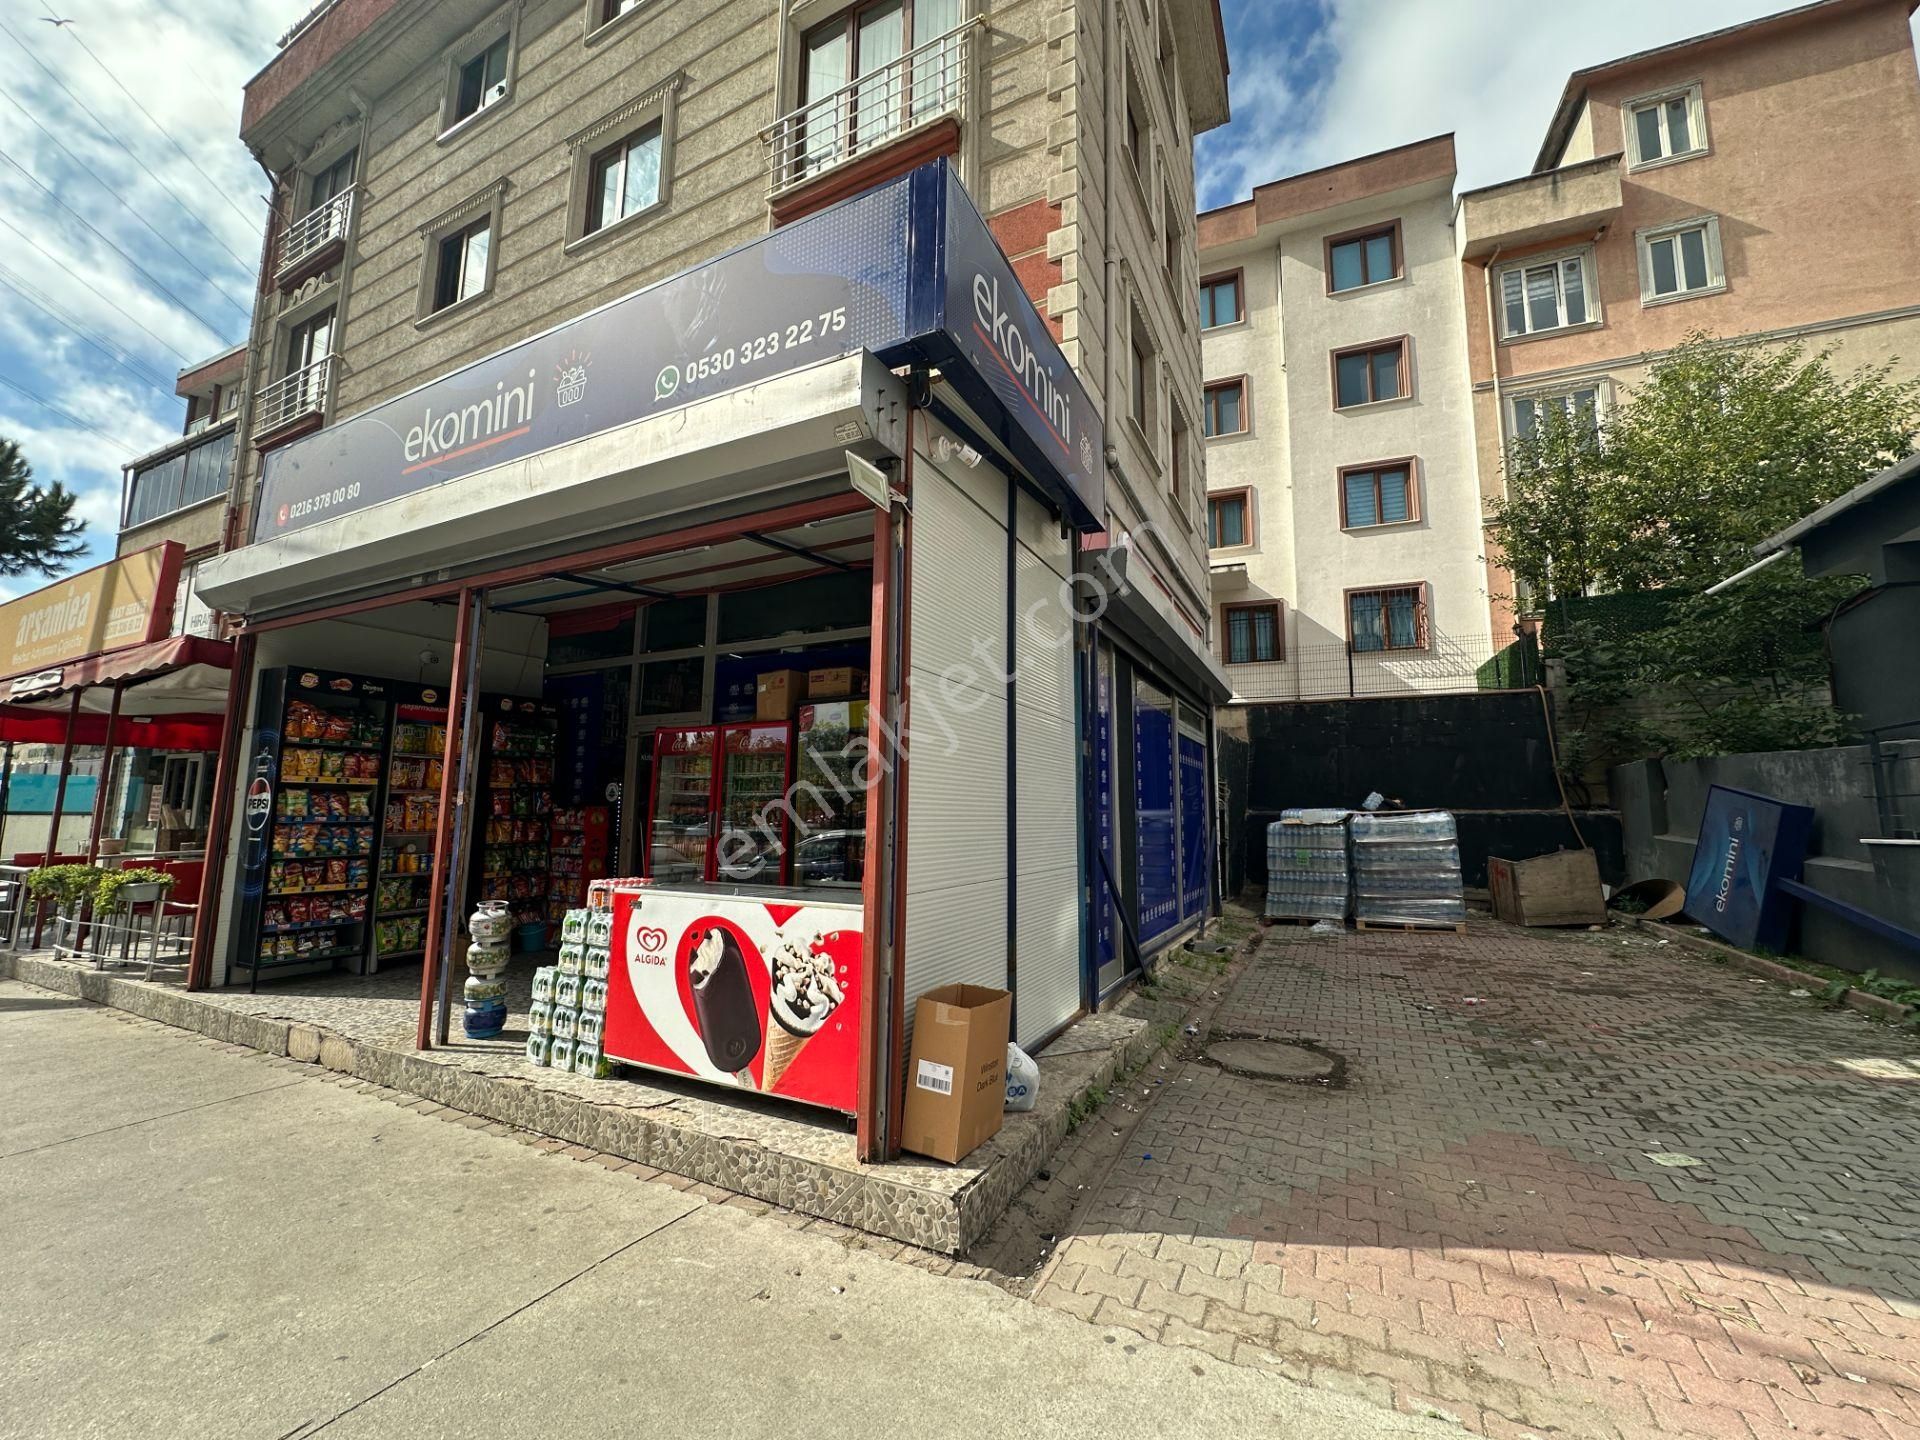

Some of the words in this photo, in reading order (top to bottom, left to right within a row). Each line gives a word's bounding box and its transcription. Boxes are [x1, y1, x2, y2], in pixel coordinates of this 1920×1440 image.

[685, 348, 735, 385] 0530
[740, 331, 780, 365] 323
[784, 319, 813, 350] 22
[818, 306, 846, 337] 75
[972, 272, 1071, 445] ekomini
[404, 368, 536, 462] ekomini
[290, 498, 313, 519] 0216
[313, 492, 331, 511] 378
[332, 487, 346, 505] 00
[347, 481, 361, 500] 80
[248, 798, 269, 810] PEPSI
[1715, 836, 1739, 913] ekomini
[634, 953, 666, 967] ALGIDA
